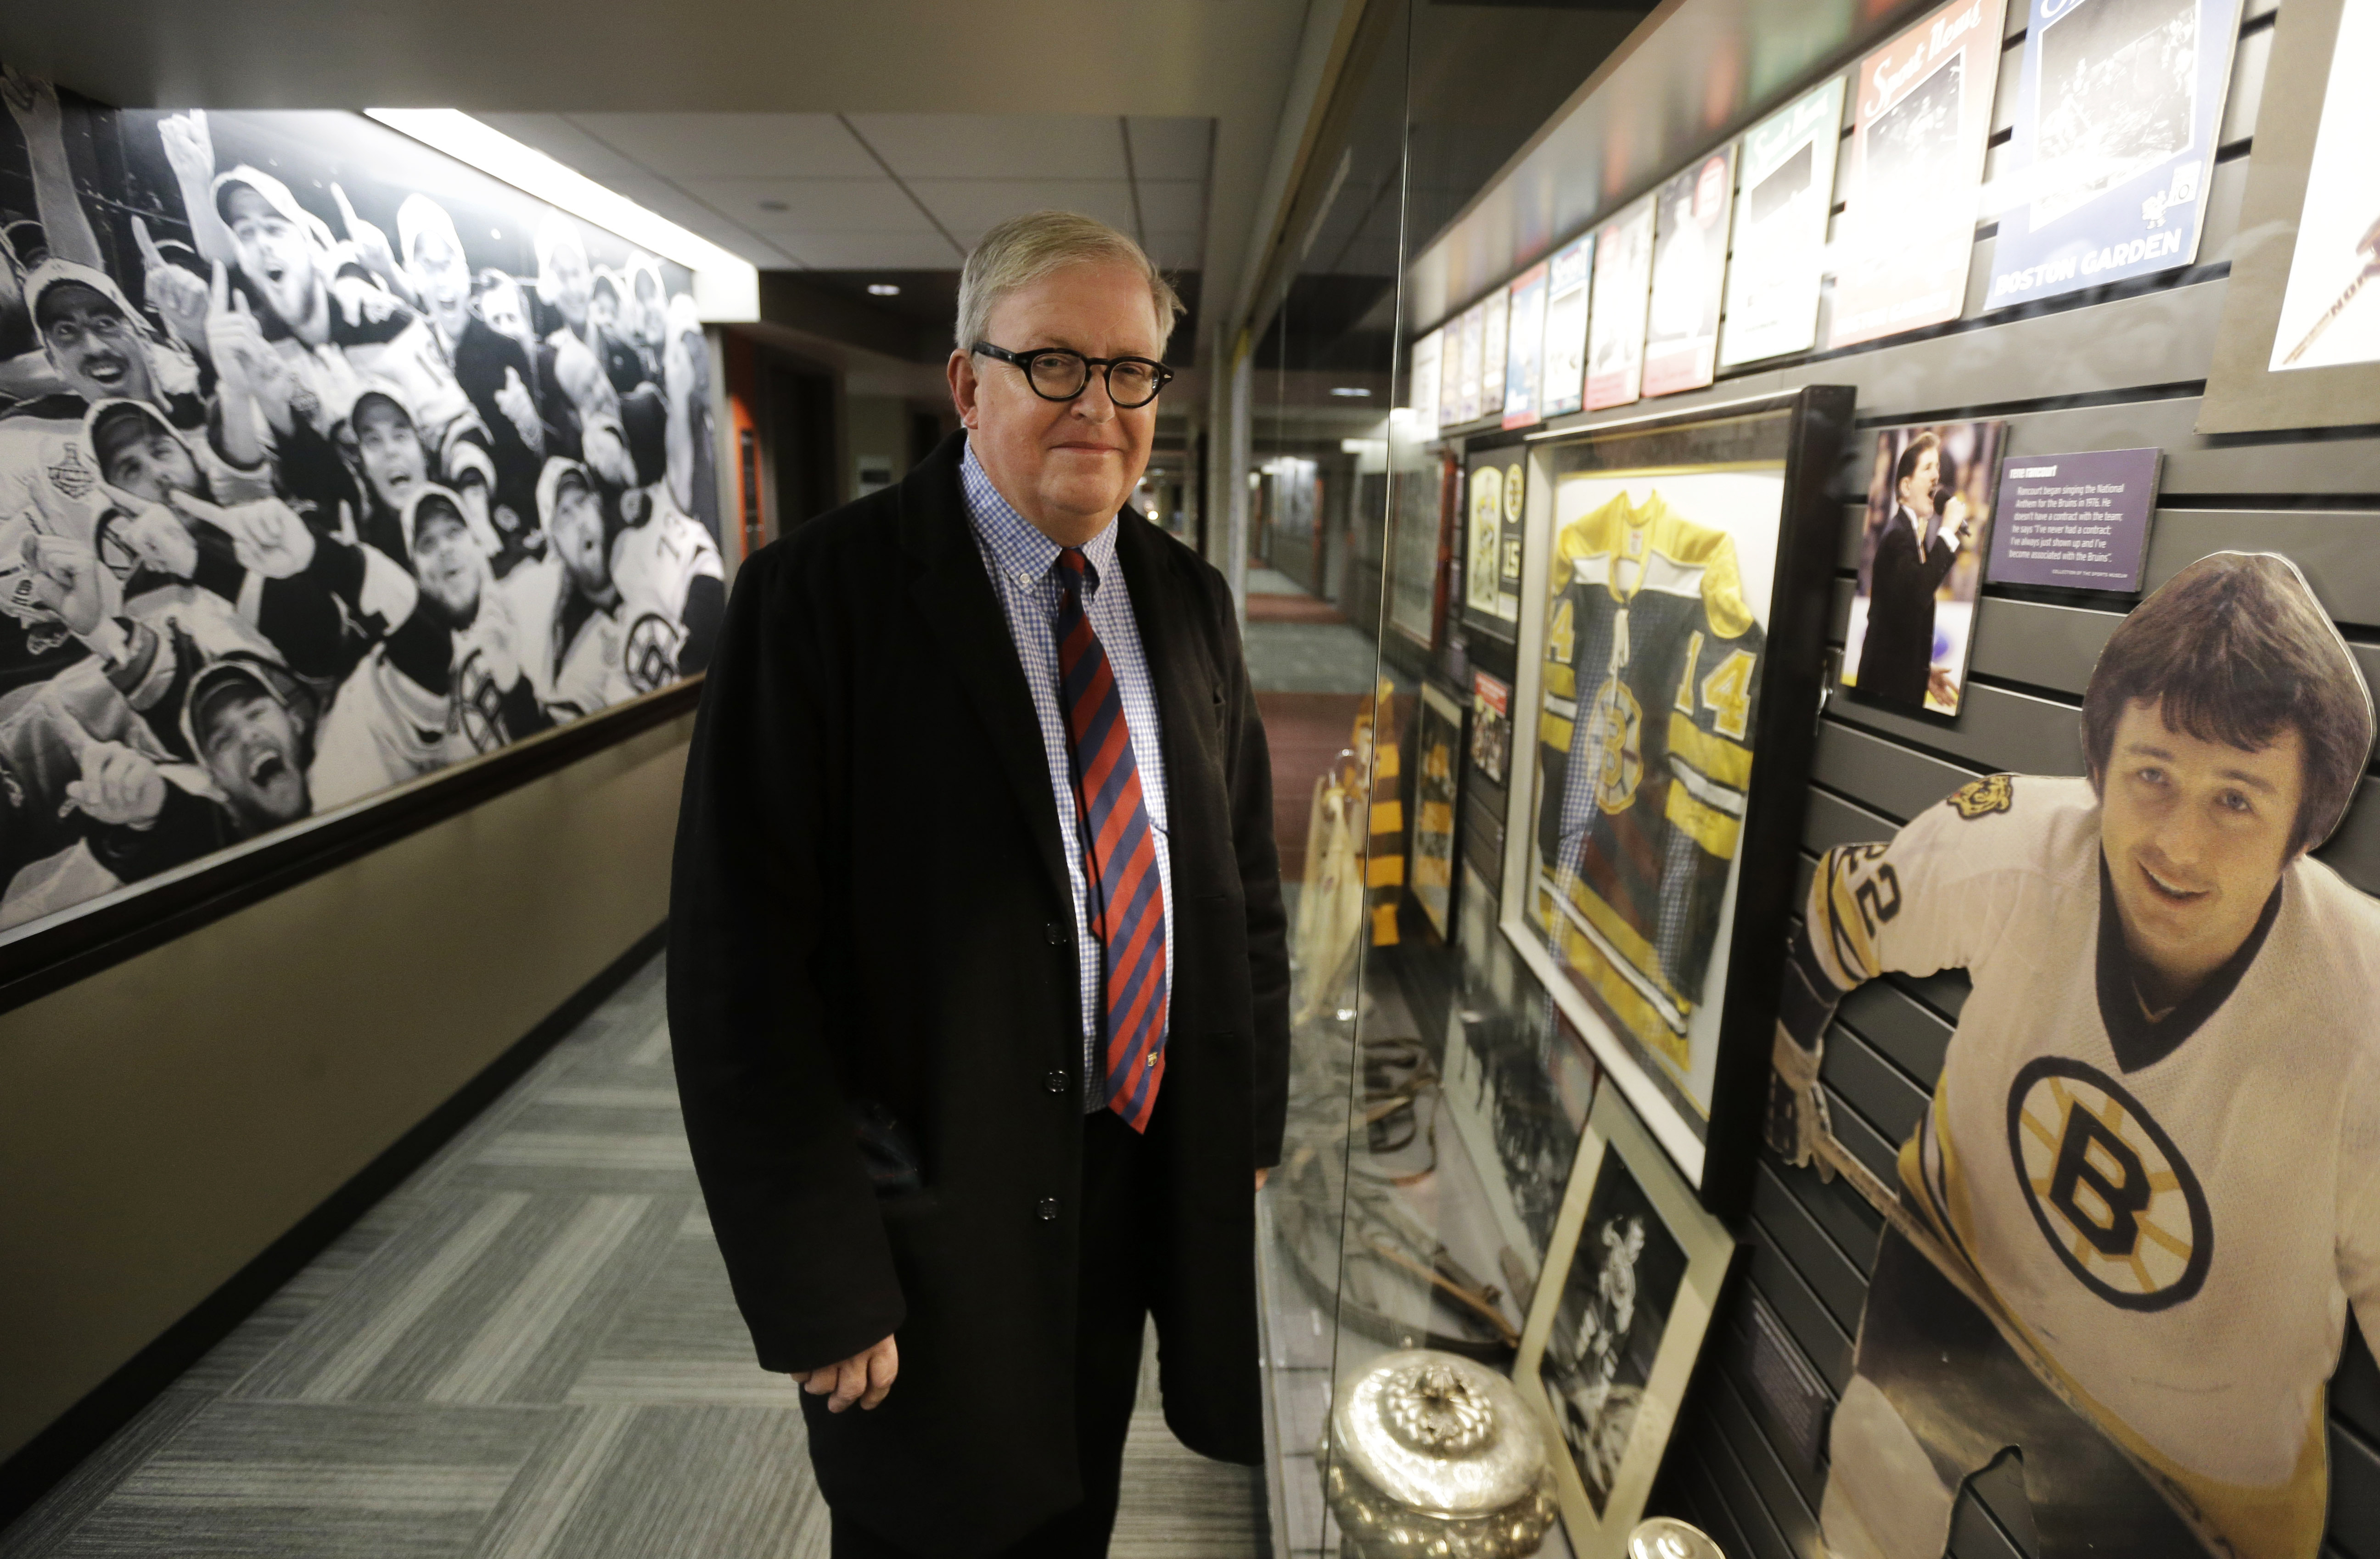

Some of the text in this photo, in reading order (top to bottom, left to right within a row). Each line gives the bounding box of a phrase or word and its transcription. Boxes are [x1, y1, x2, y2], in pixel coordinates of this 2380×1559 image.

[1994, 228, 2183, 297] BOSTON GARDEN
[2017, 483, 2124, 496] Rancourt began singing the National
[2058, 499, 2077, 507] Bruins
[2102, 498, 2111, 506] He
[2092, 512, 2103, 520] the
[2021, 538, 2039, 547] always
[2040, 538, 2051, 547] just
[2053, 538, 2071, 546] shown
[2072, 540, 2081, 549] up
[2082, 539, 2094, 547] and
[2031, 550, 2061, 560] associated
[2062, 551, 2074, 560] with
[2076, 552, 2087, 561] the
[1674, 630, 1757, 741] 14
[2049, 1099, 2153, 1259] B
